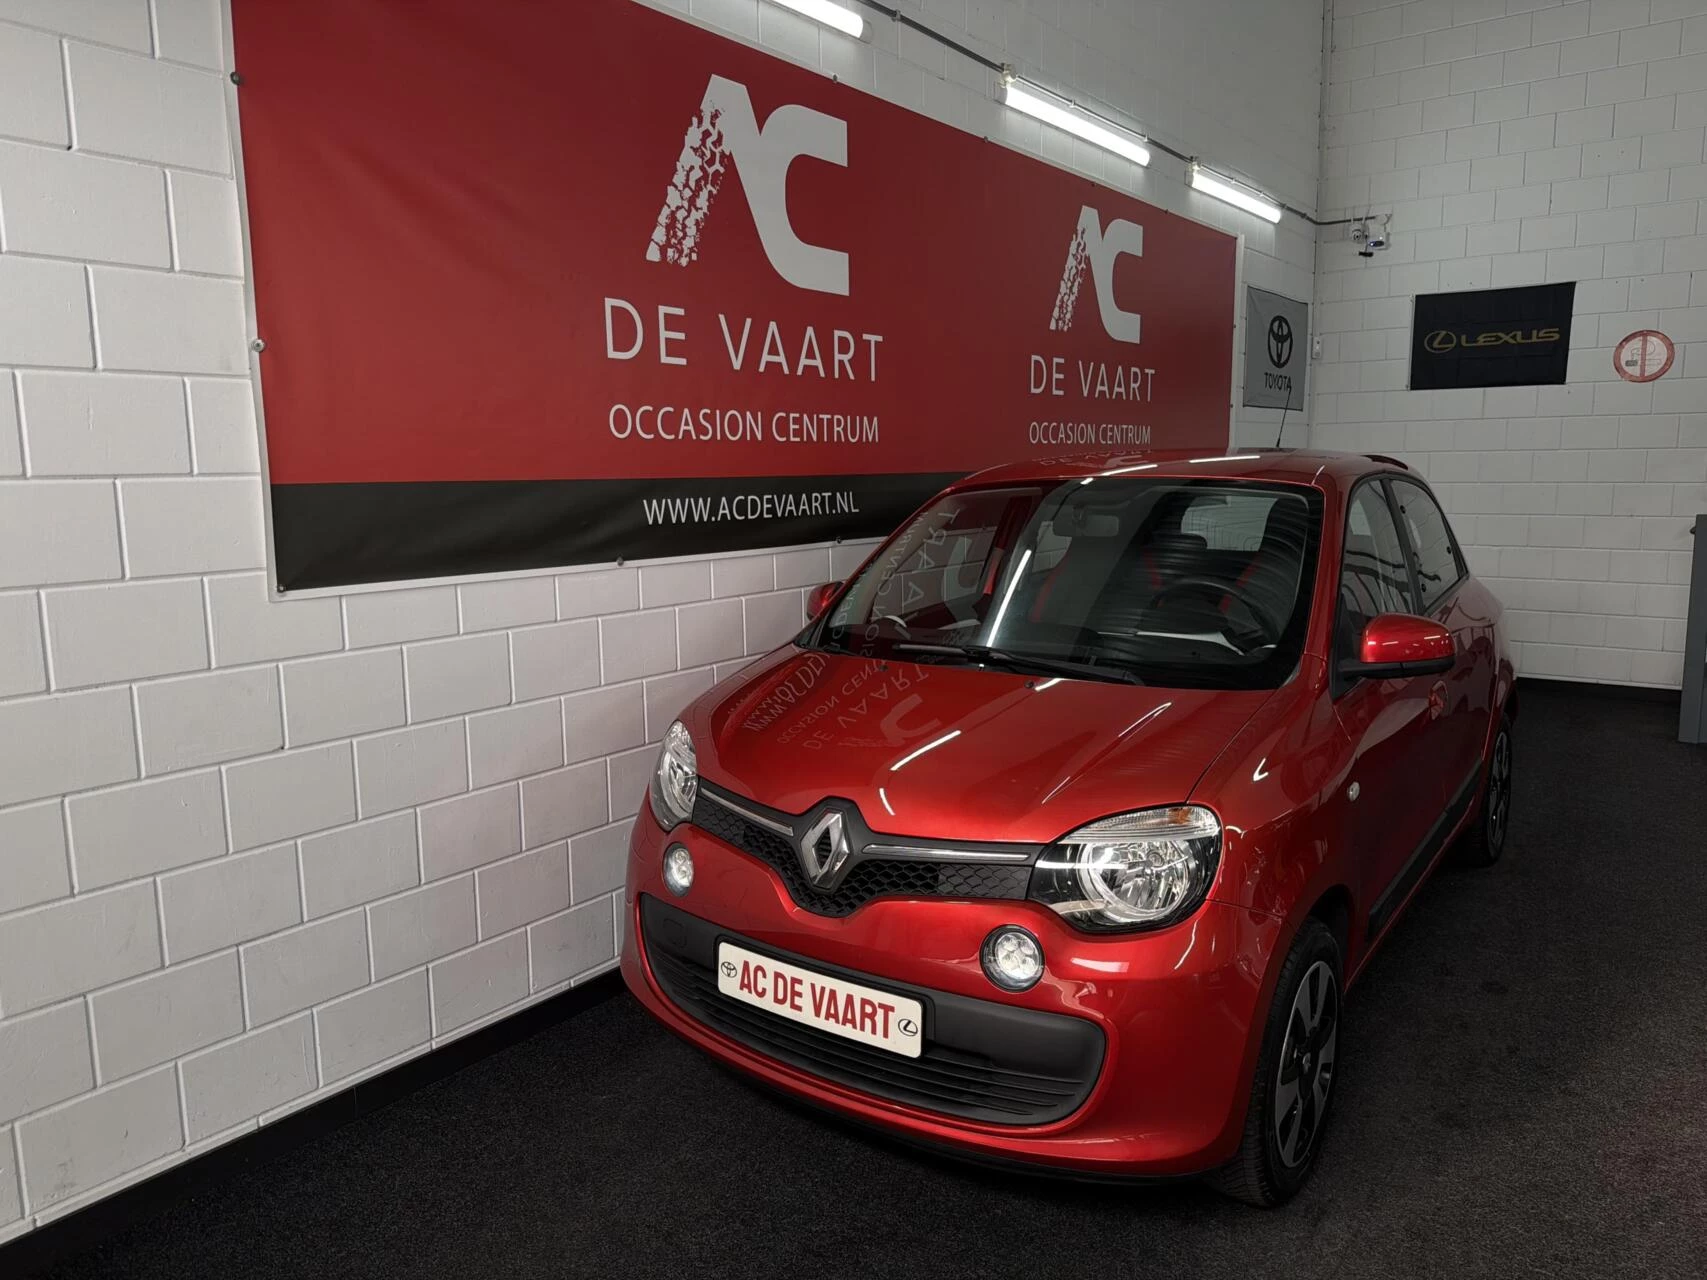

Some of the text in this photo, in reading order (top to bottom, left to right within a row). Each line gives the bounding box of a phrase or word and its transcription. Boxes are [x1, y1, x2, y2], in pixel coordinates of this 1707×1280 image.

[645, 73, 850, 297] AC
[1049, 204, 1144, 344] AC
[603, 296, 884, 382] DE VAART
[1460, 327, 1561, 347] LEXUS
[1030, 354, 1156, 402] DE VAART
[1264, 371, 1292, 392] TOYOTA
[608, 403, 880, 443] OCCASION CENTRUM
[1029, 421, 1151, 446] OCCASION CENTRUM
[642, 490, 860, 525] WWW.ACDEVAART.NL
[739, 960, 895, 1039] AC DE VAART
